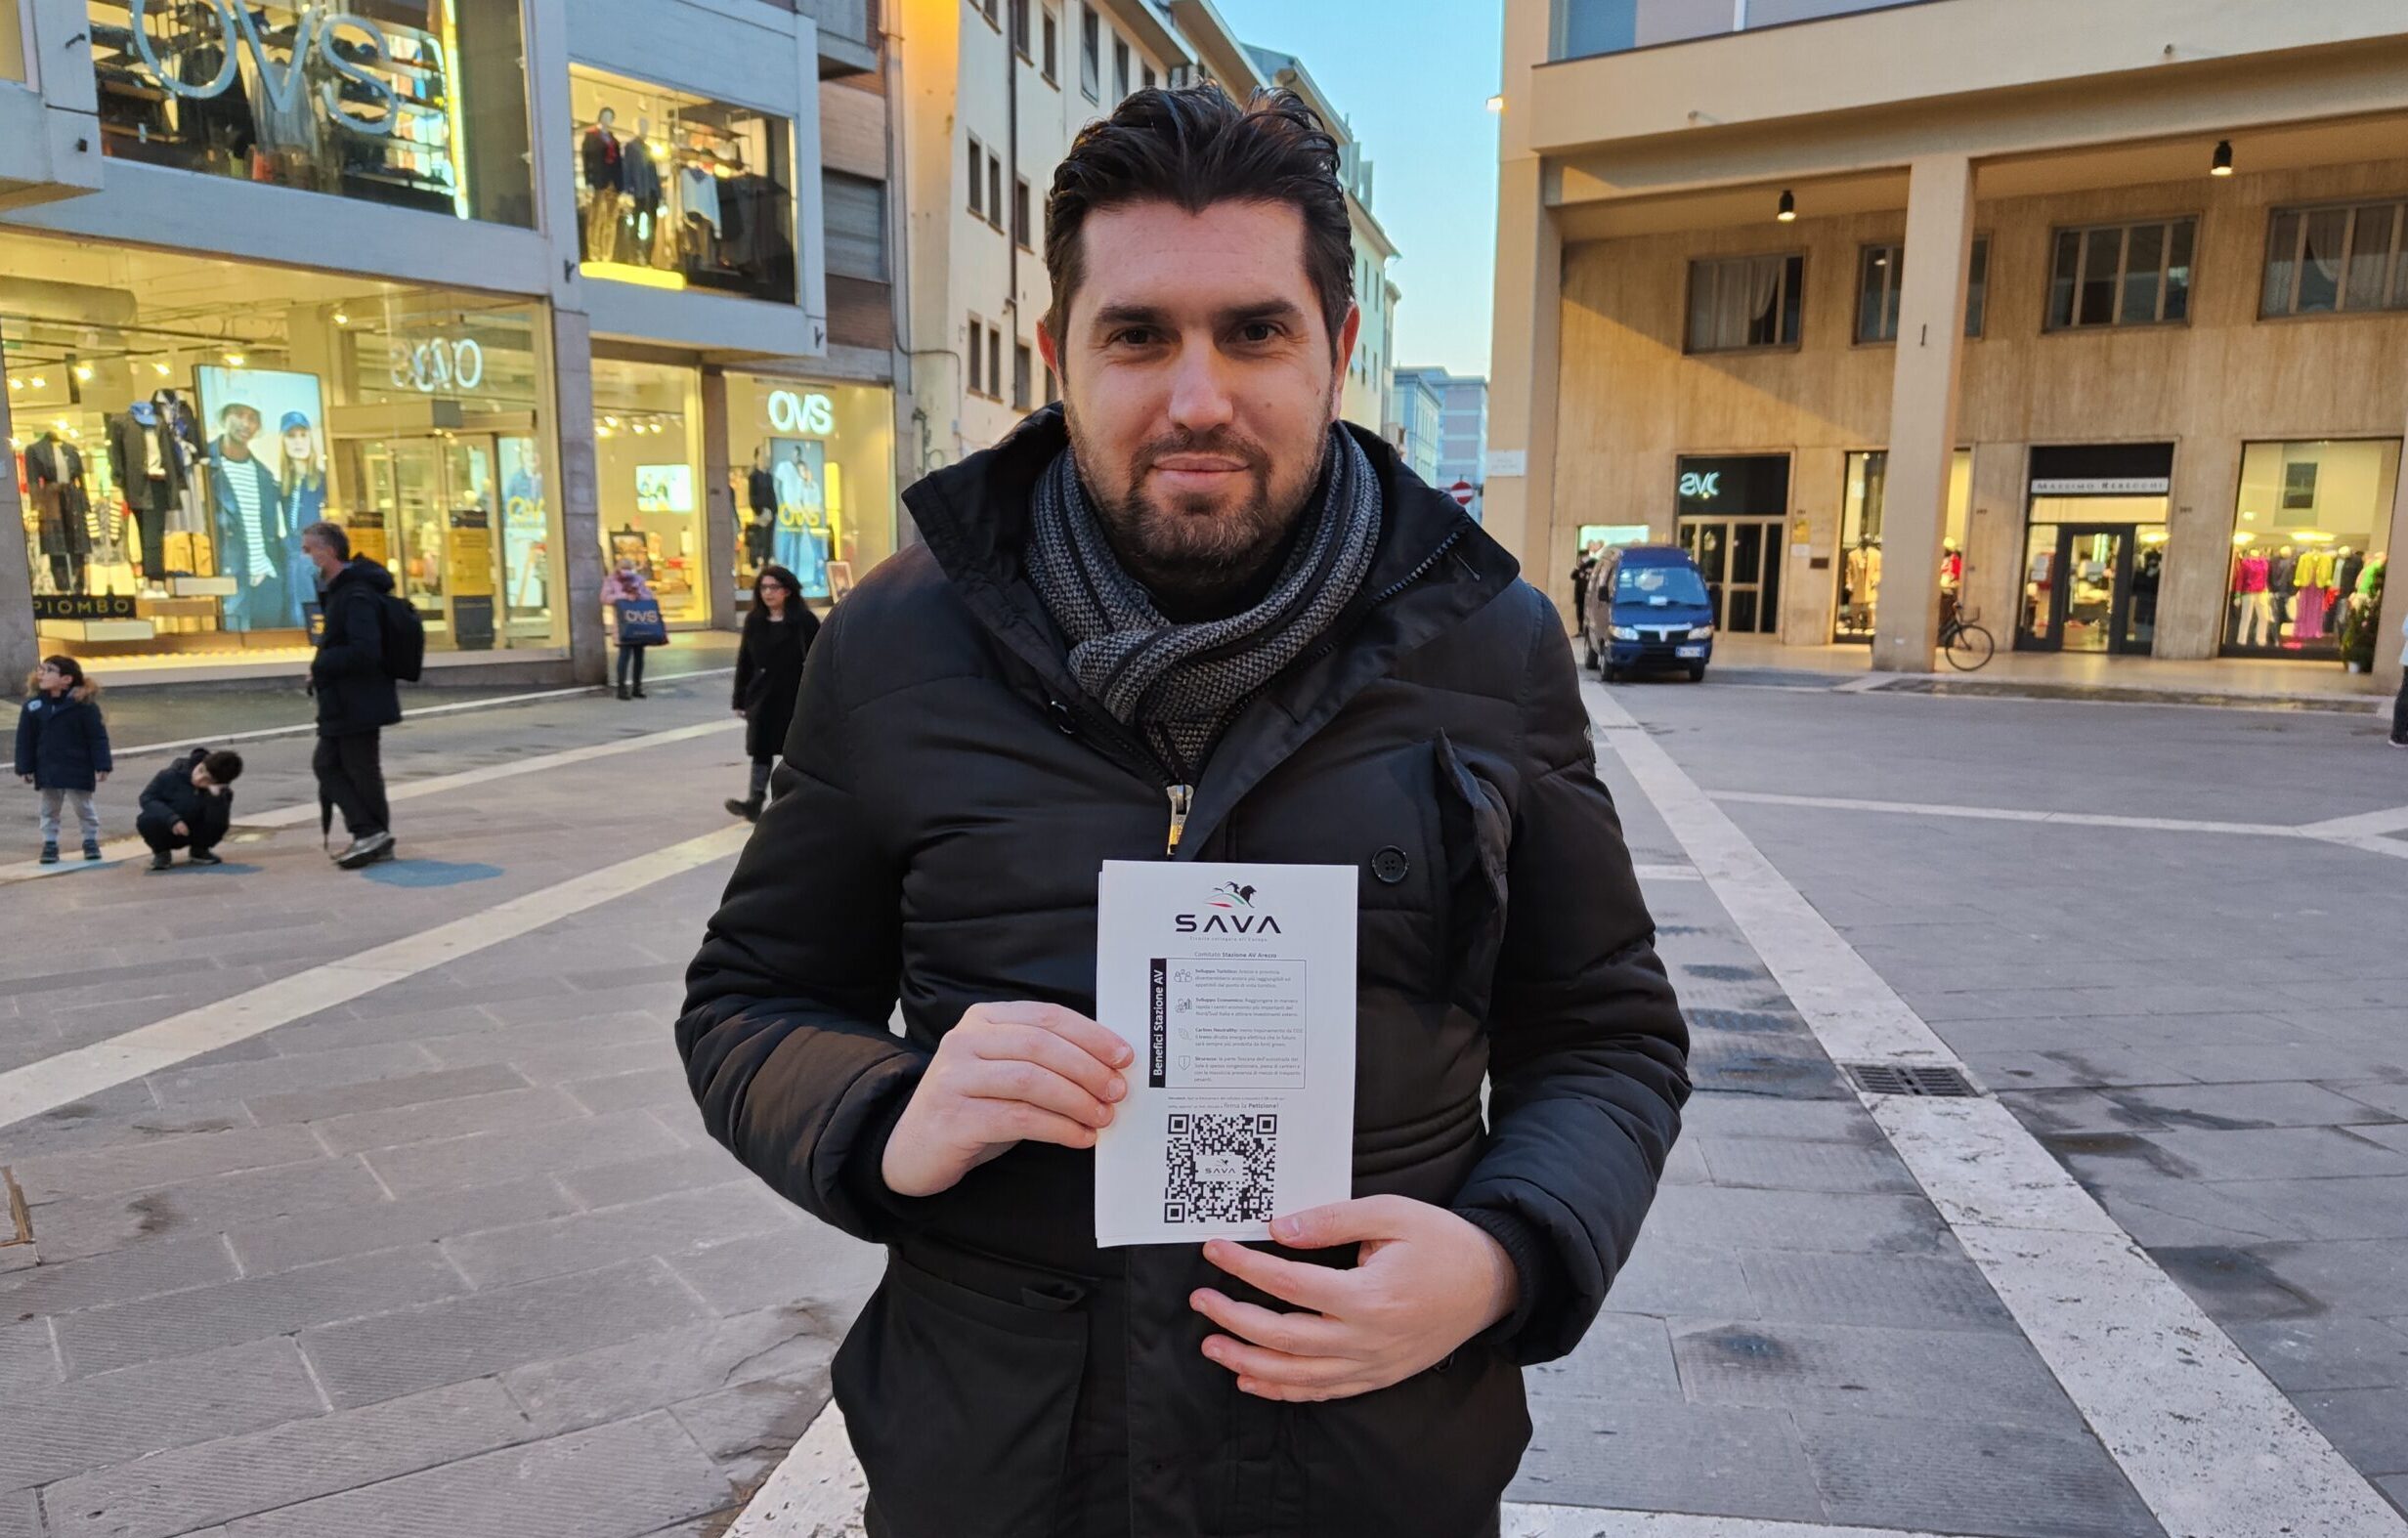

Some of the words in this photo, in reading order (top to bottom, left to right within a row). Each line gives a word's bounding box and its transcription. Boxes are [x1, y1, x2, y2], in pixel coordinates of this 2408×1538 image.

[130, 0, 398, 135] OVS
[768, 390, 832, 435] OVS
[33, 599, 129, 615] PIOMBO
[625, 610, 658, 623] OVS
[1175, 914, 1281, 934] SAVA
[1154, 969, 1163, 985] AV
[1153, 986, 1163, 1031] Stazione
[1153, 1034, 1163, 1076] Benefici
